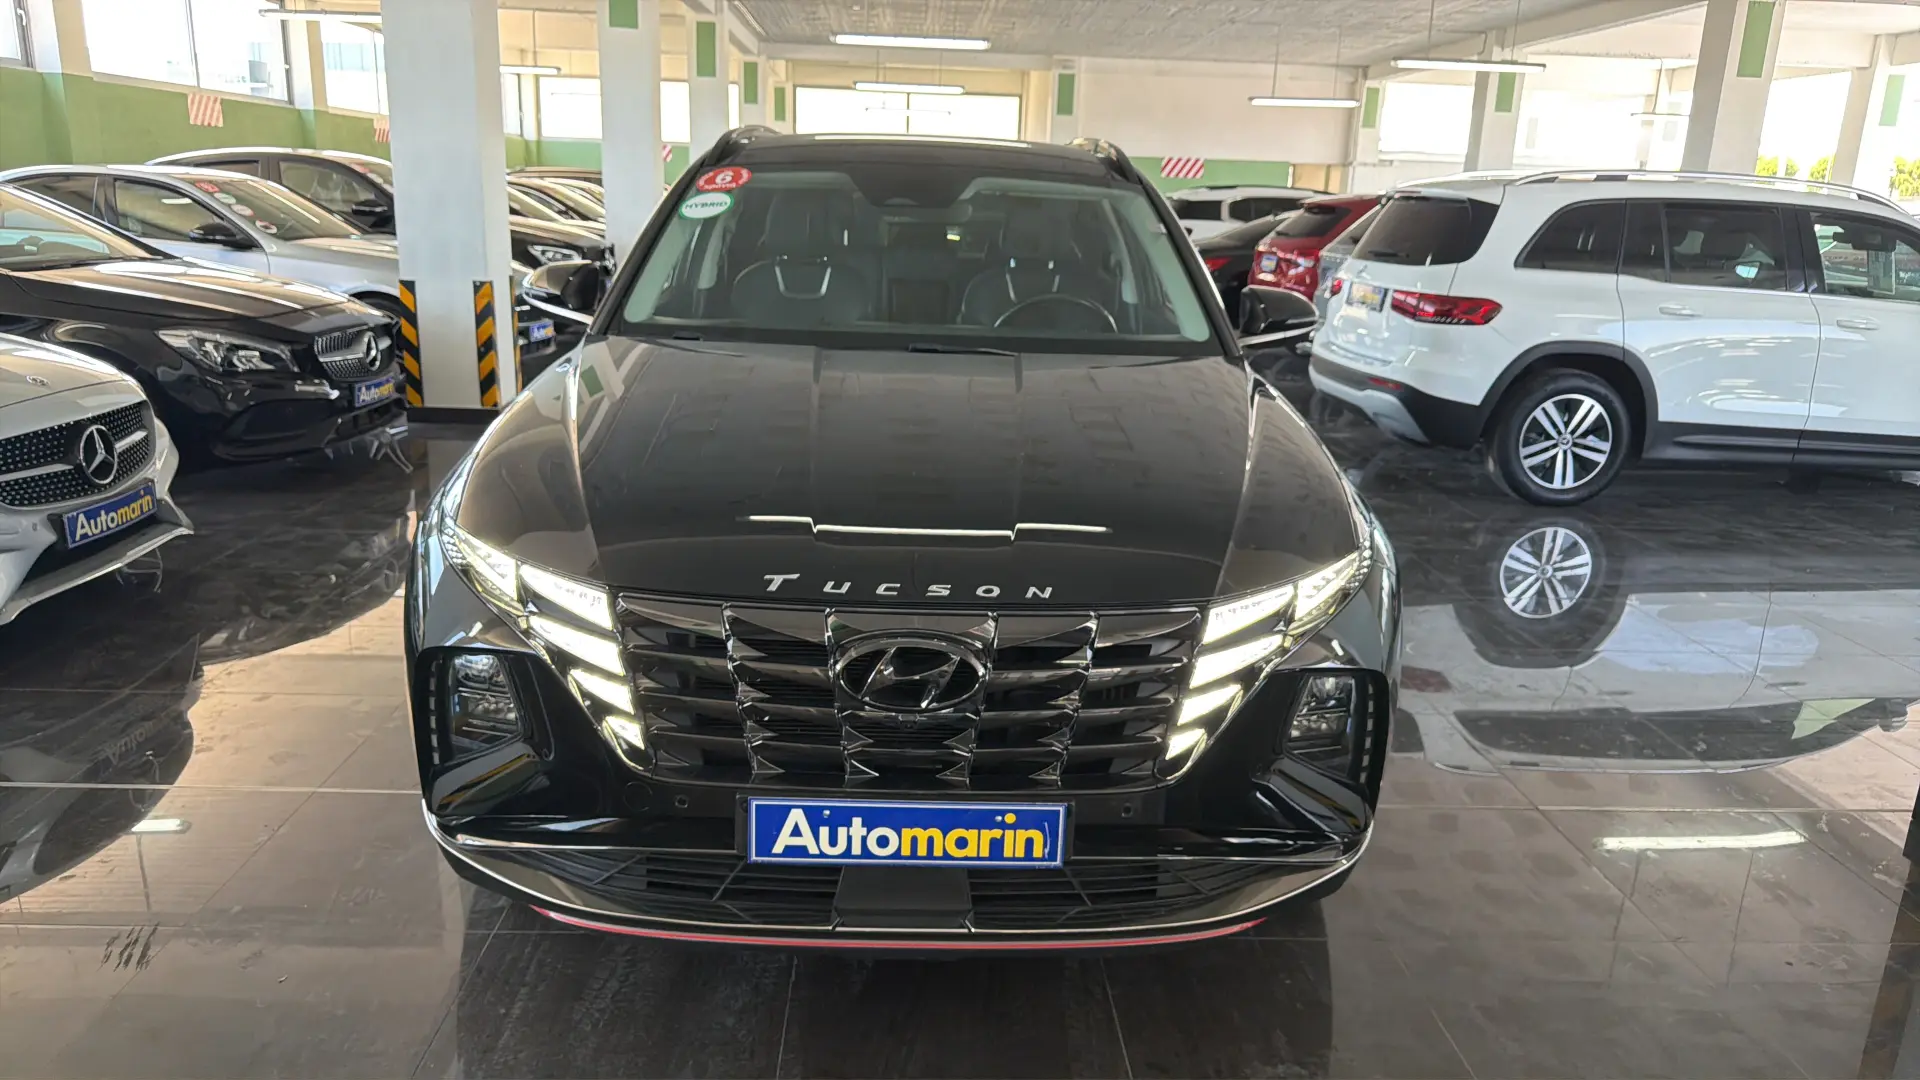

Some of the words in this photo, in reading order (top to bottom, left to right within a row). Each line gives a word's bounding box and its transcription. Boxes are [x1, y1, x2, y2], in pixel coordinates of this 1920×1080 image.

[685, 201, 728, 209] HYBRID
[75, 489, 153, 541] Automarin
[771, 807, 1045, 859] Automarin
